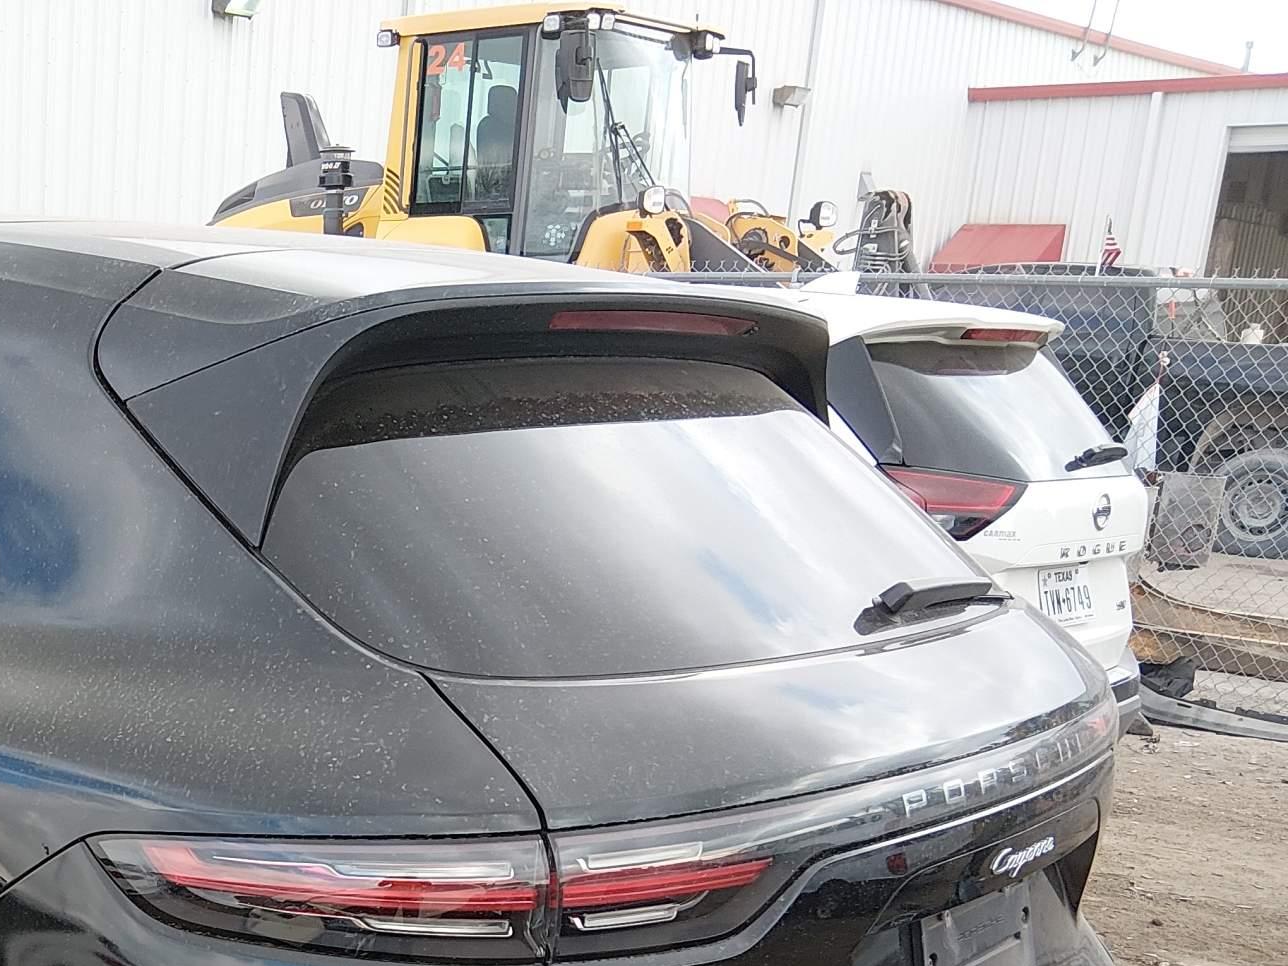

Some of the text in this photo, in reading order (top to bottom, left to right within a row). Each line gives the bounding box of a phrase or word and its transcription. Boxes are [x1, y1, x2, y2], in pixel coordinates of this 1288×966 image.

[427, 42, 465, 76] 24
[1059, 540, 1127, 559] ROGUE
[1053, 570, 1073, 583] TEXAS
